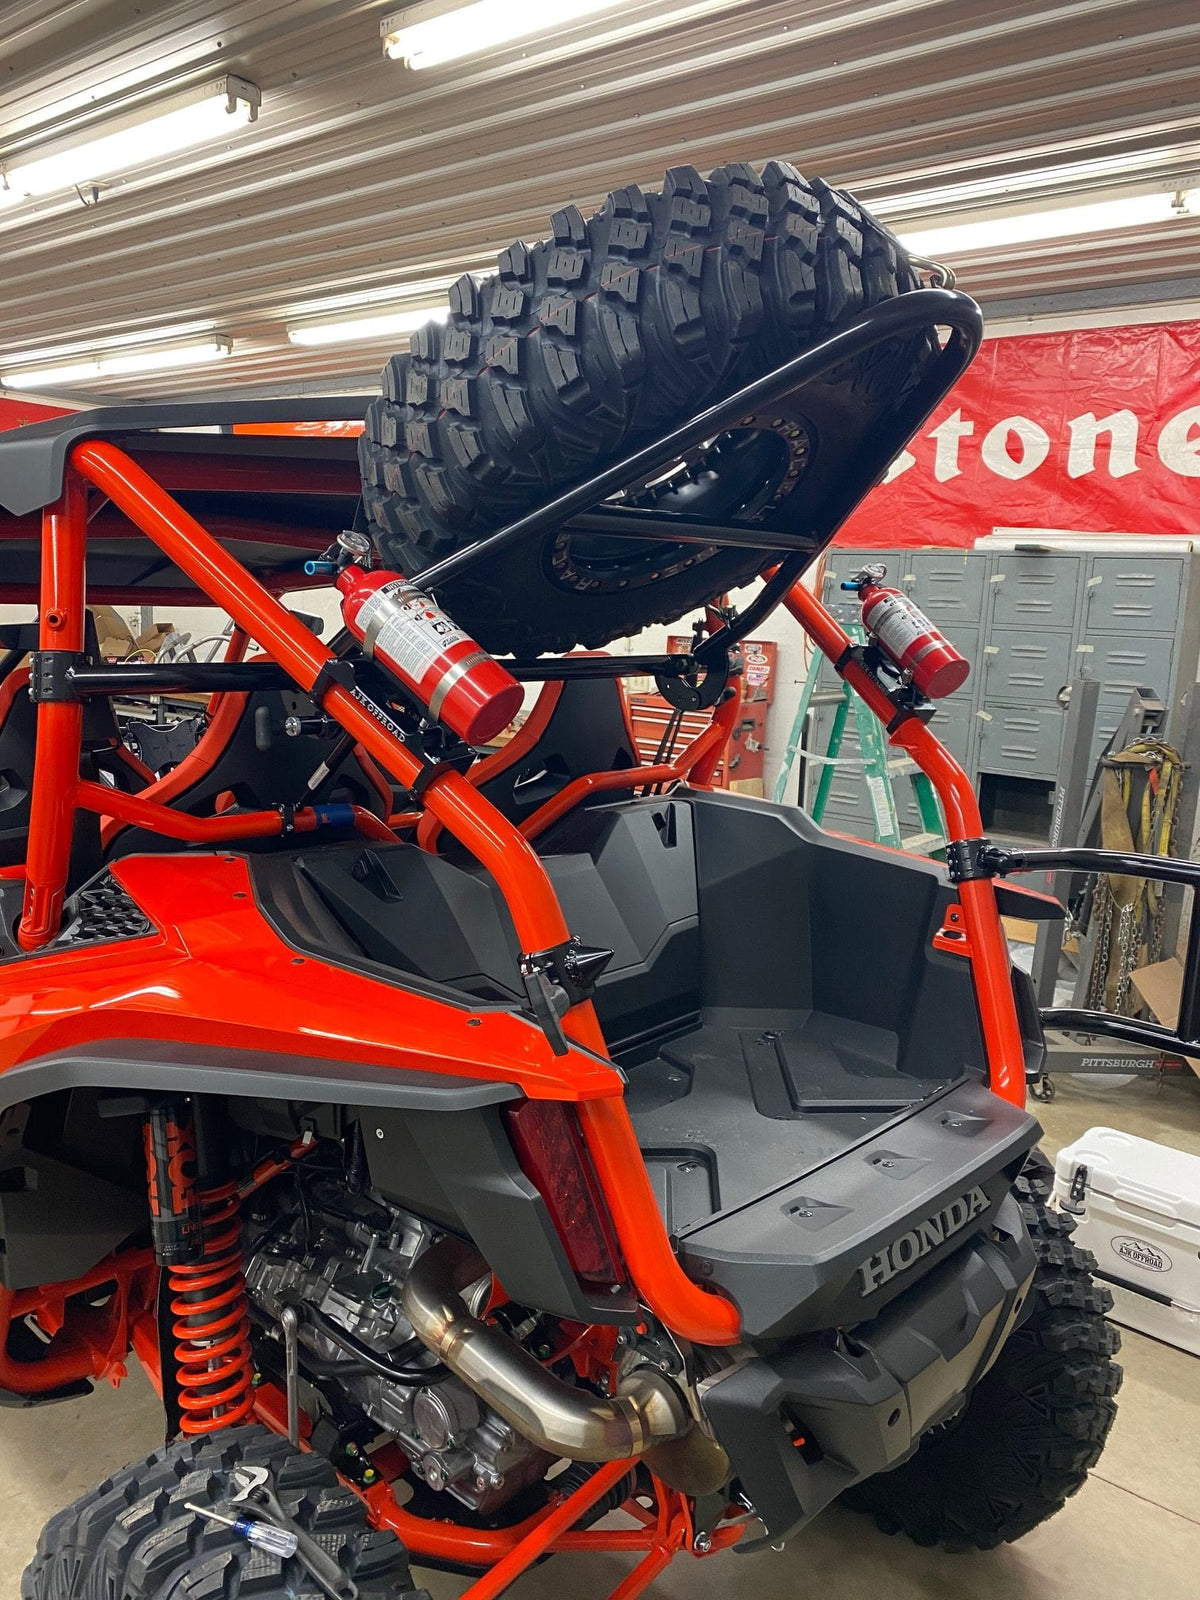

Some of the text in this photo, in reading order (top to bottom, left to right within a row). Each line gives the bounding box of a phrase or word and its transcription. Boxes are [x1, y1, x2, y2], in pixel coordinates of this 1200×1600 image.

[883, 407, 1200, 485] tone
[349, 687, 406, 744] AJK OFFROAD
[1051, 785, 1066, 848] PITTSBURG
[1080, 1057, 1155, 1069] PITTSBURGH
[857, 1184, 992, 1297] HONDA
[1119, 1246, 1163, 1269] AJK OFFROAD
